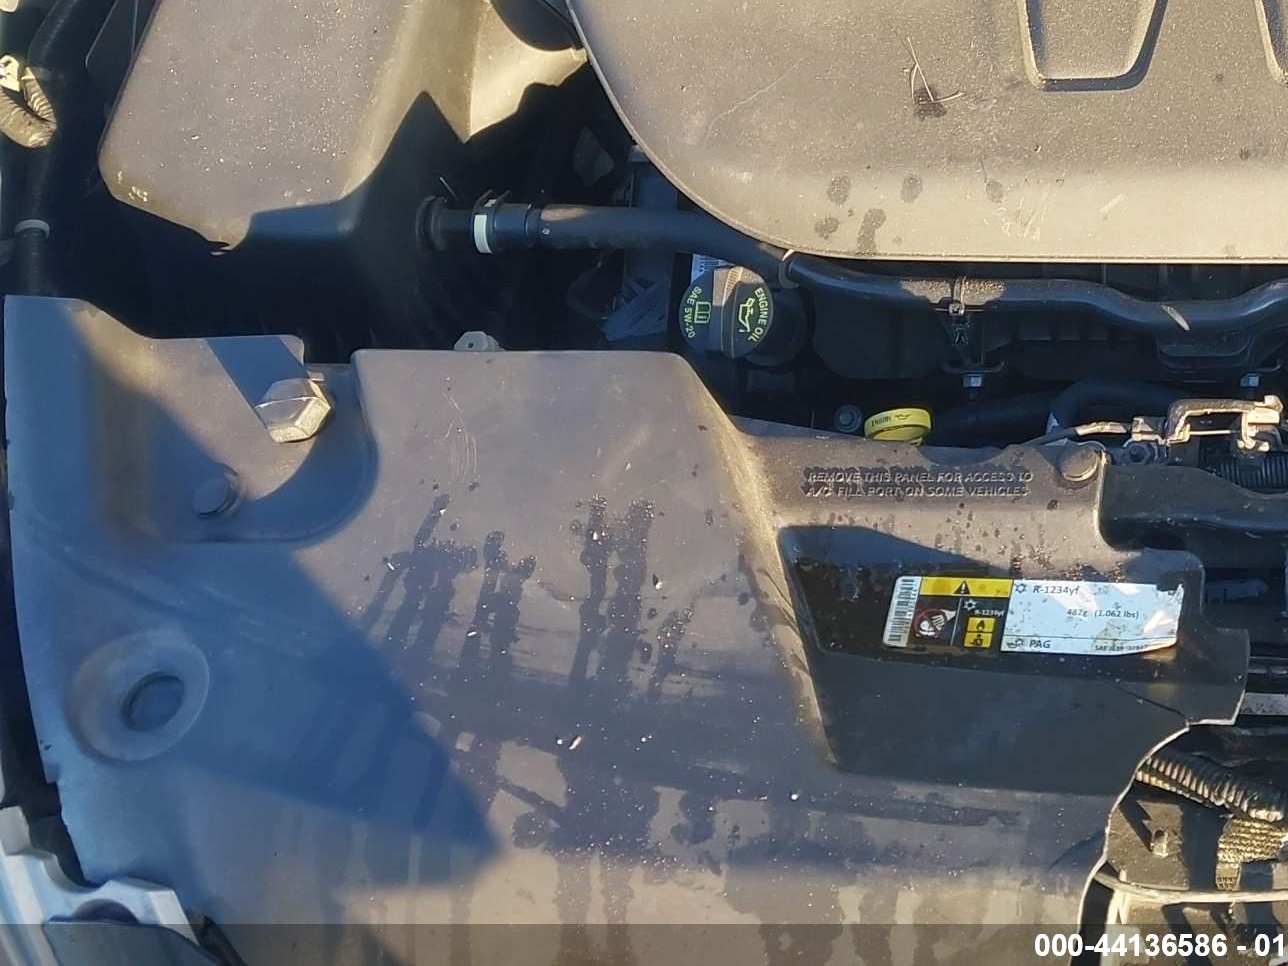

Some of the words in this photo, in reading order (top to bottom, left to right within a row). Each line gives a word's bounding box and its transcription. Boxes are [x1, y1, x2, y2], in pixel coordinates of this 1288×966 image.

[687, 286, 702, 305] SAE
[754, 287, 769, 325] ENGINE
[683, 307, 696, 339] 5W-20
[747, 326, 764, 342] OIL
[808, 472, 861, 483] REMOVE
[864, 472, 891, 483] THIS
[894, 472, 935, 483] PANEL
[937, 472, 962, 483] FOR
[964, 472, 1015, 483] ACCESS
[1018, 472, 1034, 483] TO
[805, 486, 832, 497] A/C
[837, 486, 862, 497] FILL
[868, 486, 901, 497] PORT
[906, 486, 924, 497] ON
[927, 486, 965, 497] SOME
[968, 486, 1031, 497] VEHICLES
[1032, 585, 1081, 595] R-1234yf
[1094, 609, 1122, 619] (1.062
[1123, 610, 1140, 620] lbs)
[1028, 639, 1051, 649] PAG
